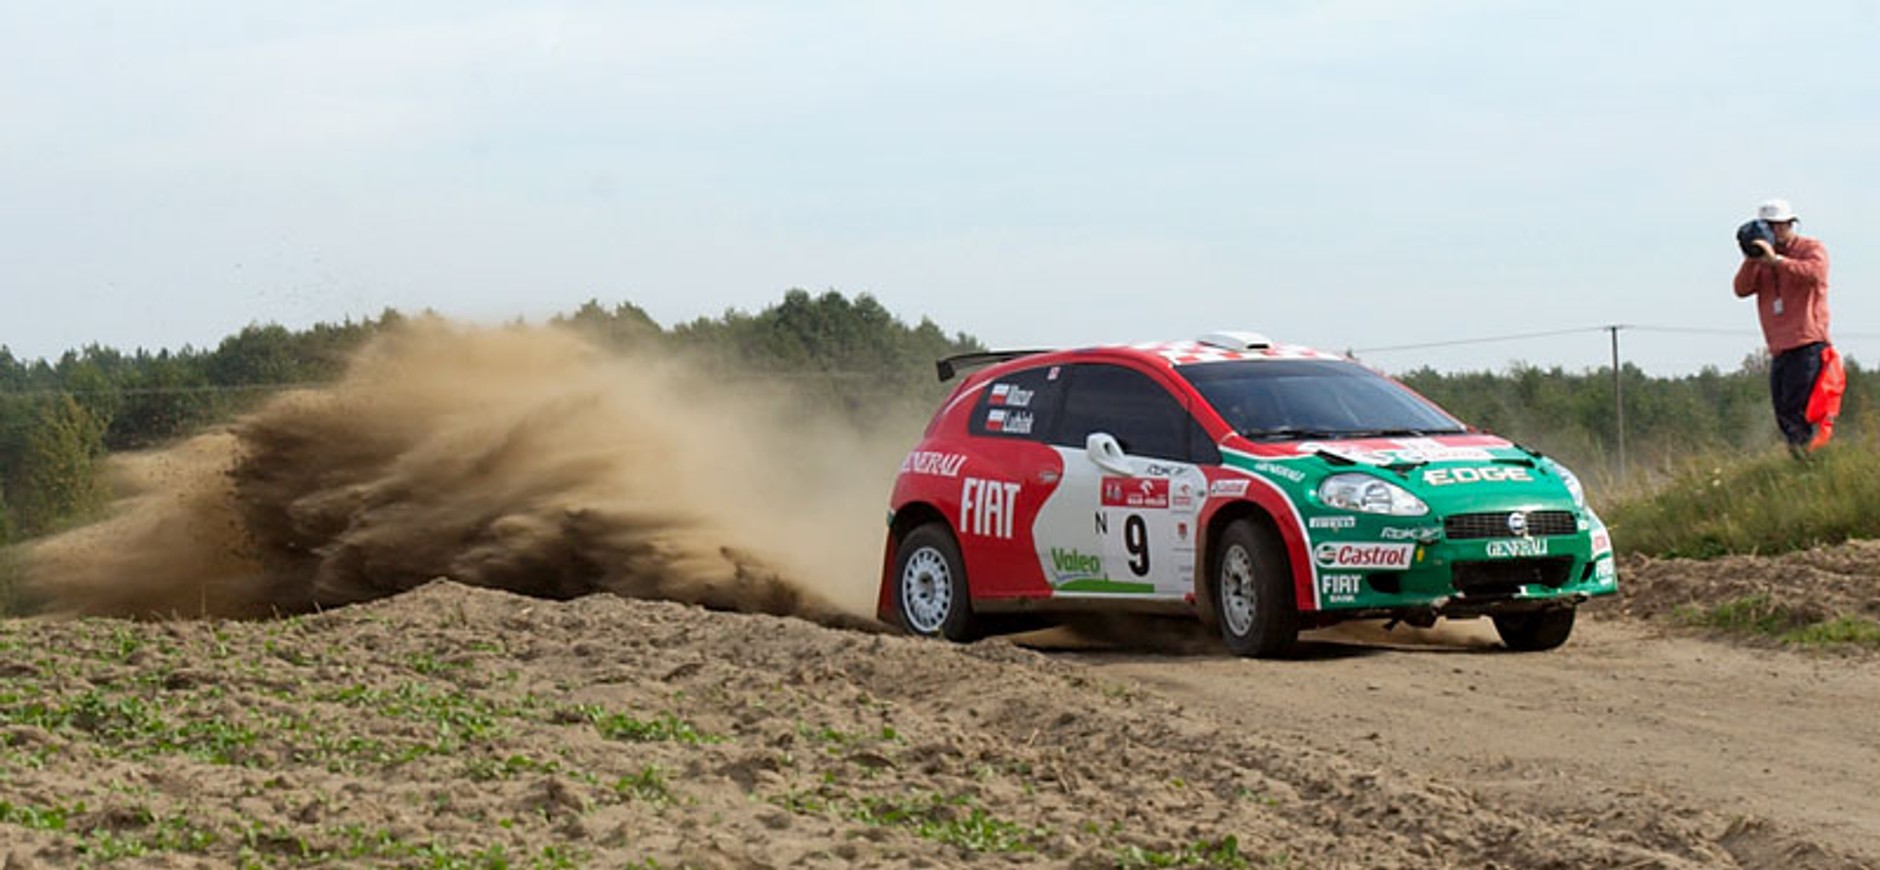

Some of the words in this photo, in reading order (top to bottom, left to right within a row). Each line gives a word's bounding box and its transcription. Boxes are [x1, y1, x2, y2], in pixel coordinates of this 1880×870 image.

[902, 451, 968, 477] ENERALI
[1424, 467, 1534, 486] EDGE
[960, 477, 1021, 539] FIAT
[1095, 511, 1108, 534] N
[1125, 514, 1150, 577] 9
[1338, 545, 1408, 566] Castrol
[1486, 538, 1548, 557] GENERALI
[1051, 546, 1101, 573] Valeo
[1322, 574, 1361, 594] FIAT
